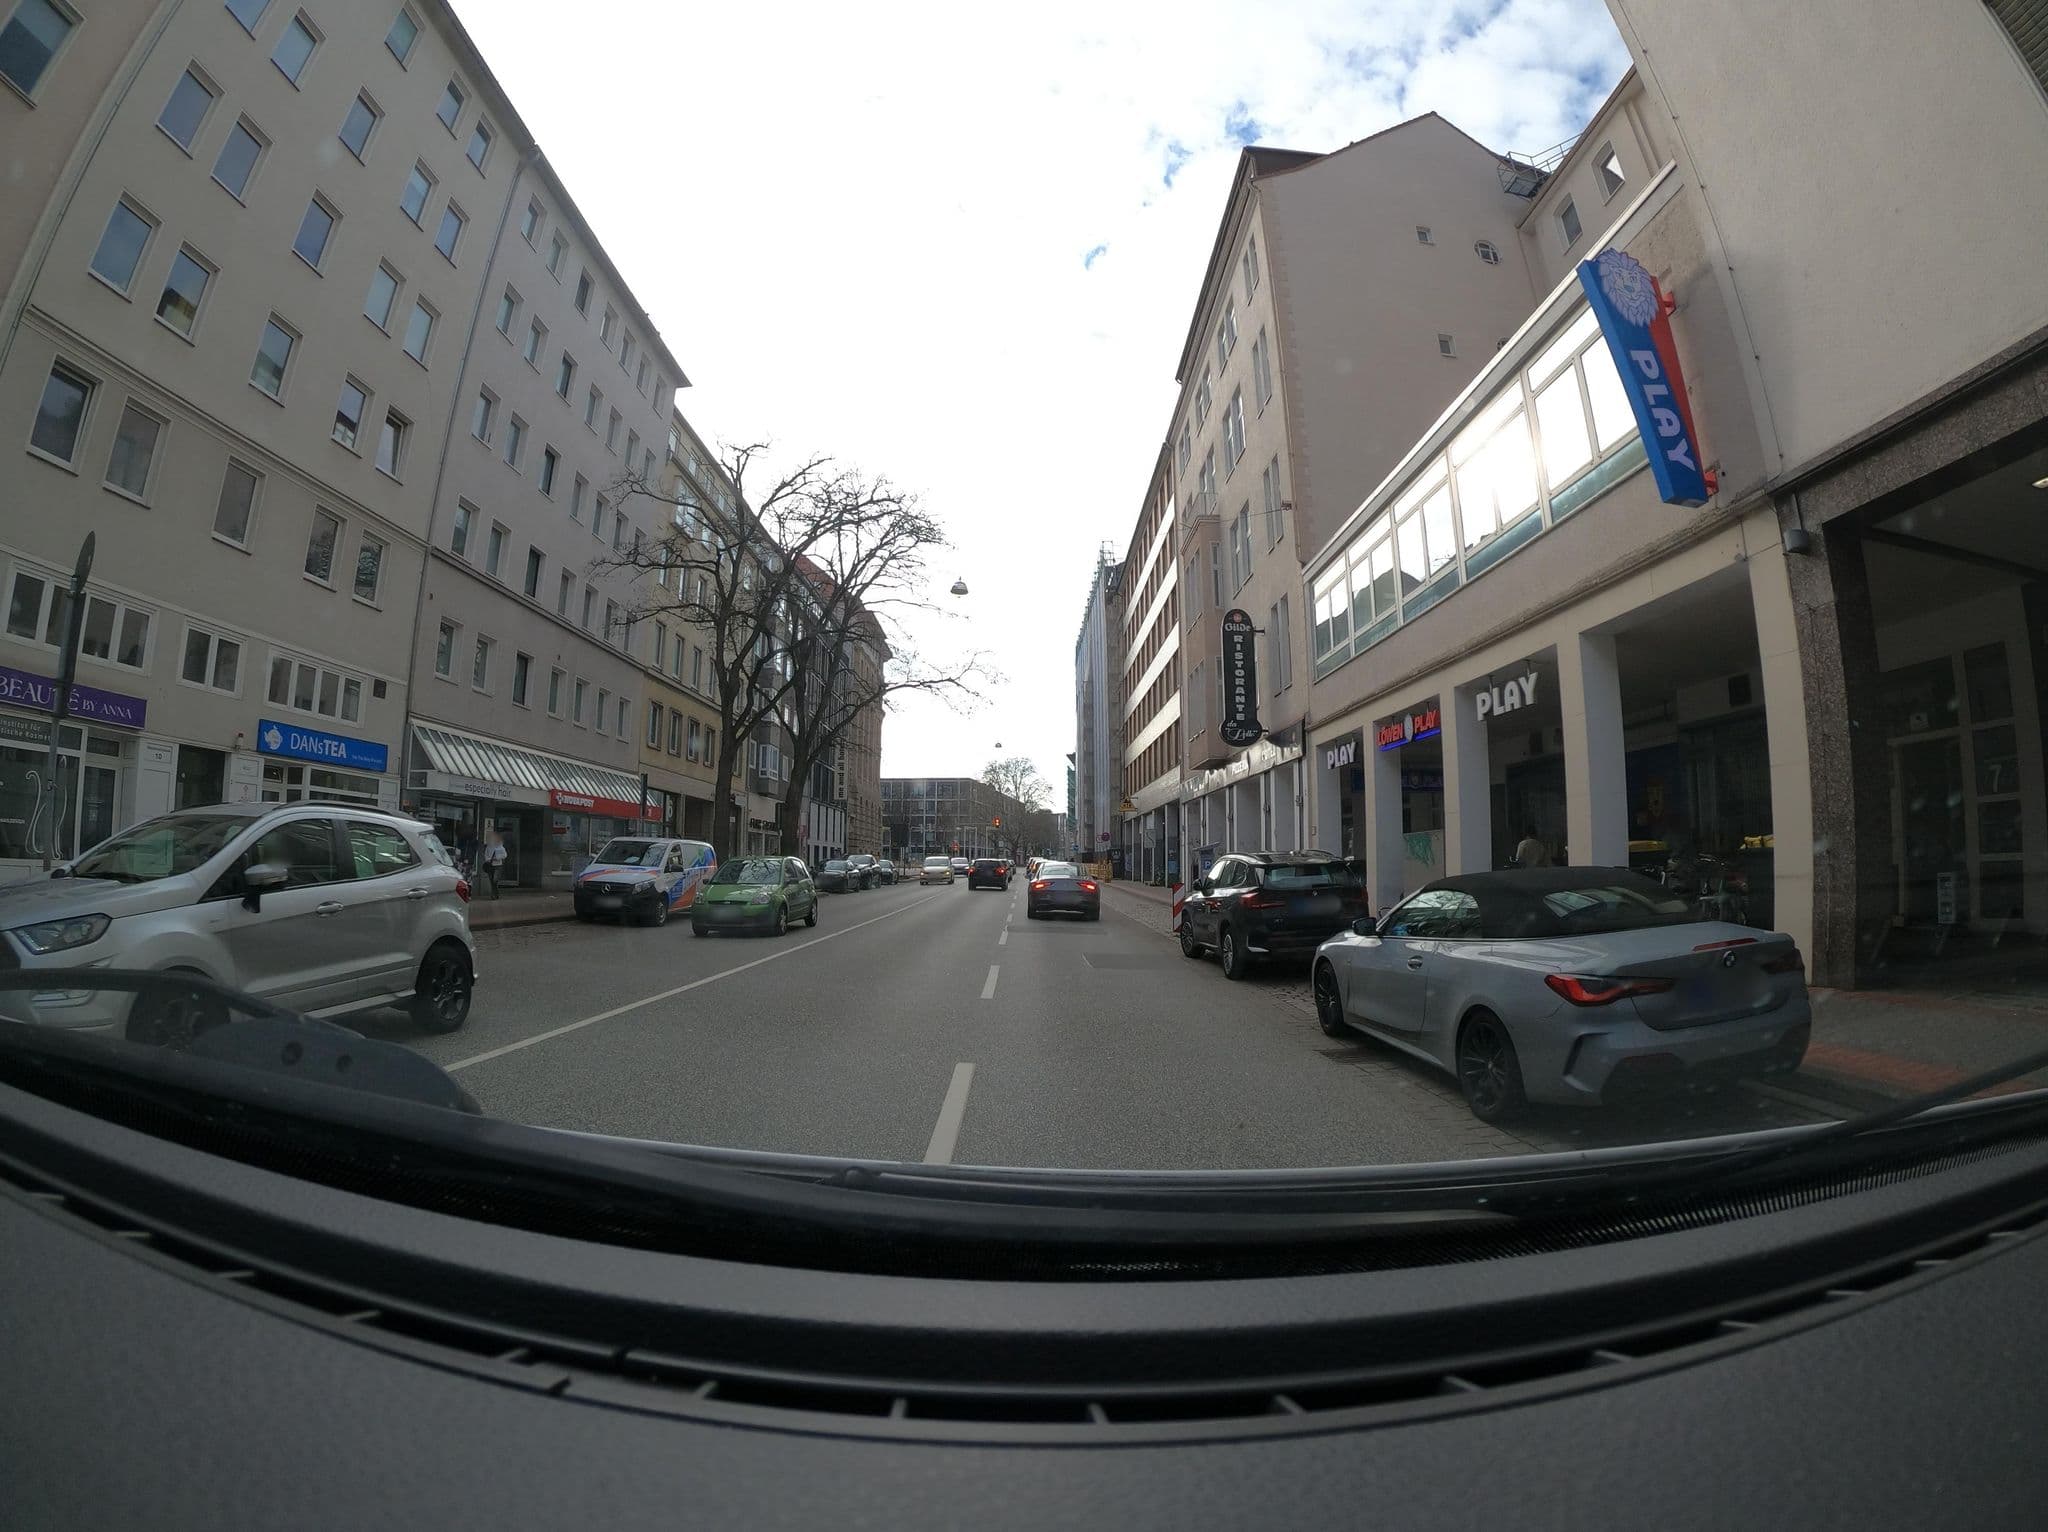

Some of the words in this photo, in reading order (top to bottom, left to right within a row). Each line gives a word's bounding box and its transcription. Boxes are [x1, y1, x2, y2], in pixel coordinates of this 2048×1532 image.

[1630, 350, 1697, 472] PLAY
[0, 676, 80, 711] BEAUÉ
[82, 699, 98, 712] BY
[100, 703, 133, 719] ANNA
[1233, 635, 1246, 721] RISTORANTE
[1476, 672, 1539, 721] PLAY
[1376, 721, 1404, 747] LÖWEN
[1414, 710, 1438, 733] PLAY
[1327, 741, 1357, 770] PLAY
